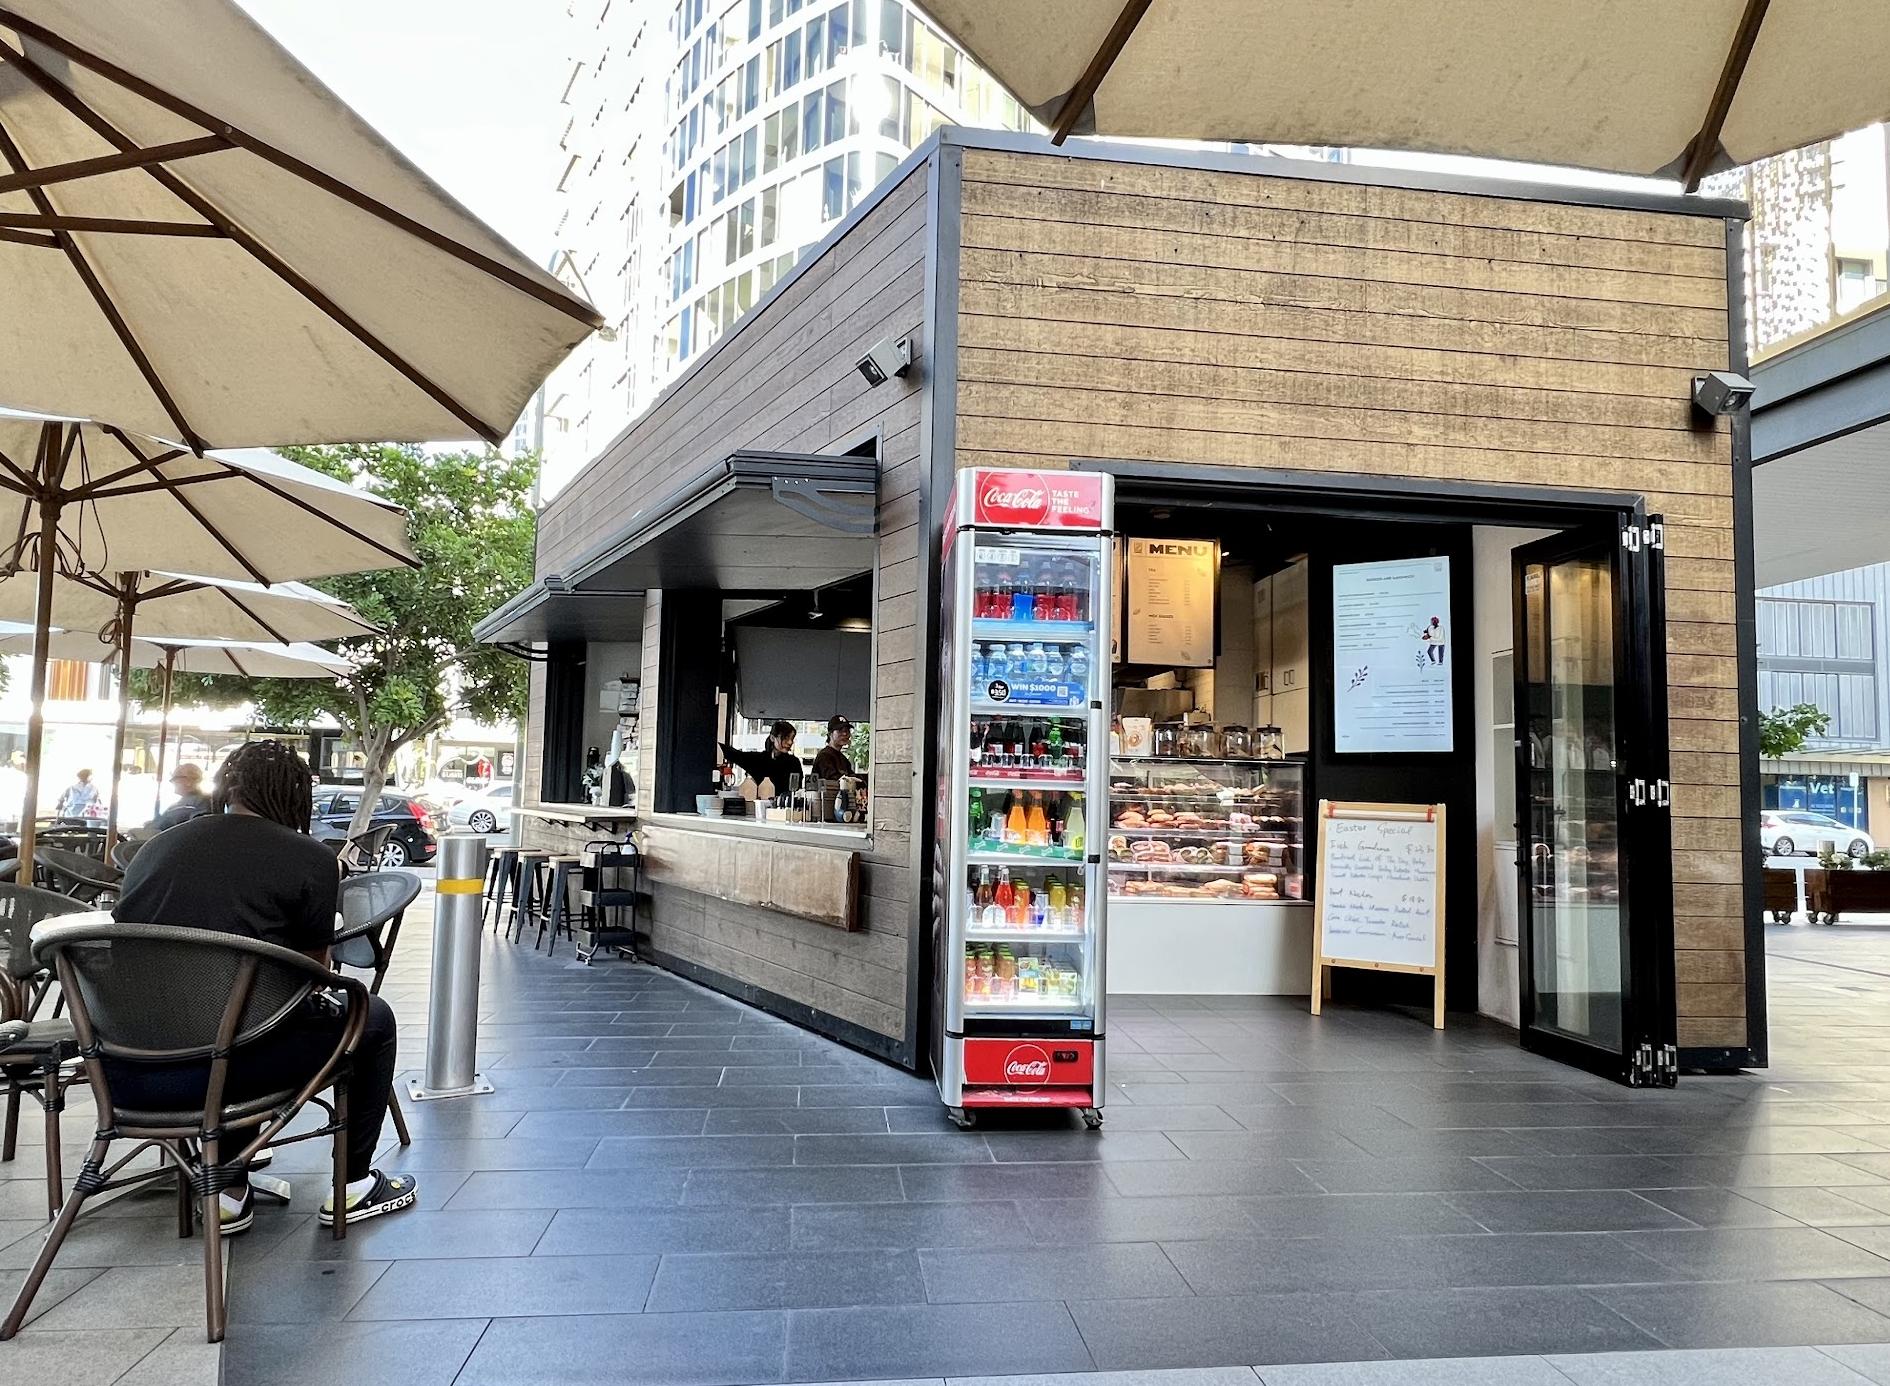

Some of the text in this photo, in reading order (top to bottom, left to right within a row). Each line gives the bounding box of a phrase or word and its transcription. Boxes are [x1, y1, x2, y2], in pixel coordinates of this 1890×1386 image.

[984, 487, 1046, 509] Coca-Cola
[1052, 490, 1079, 498] TASTE
[1052, 498, 1069, 506] THE
[1052, 506, 1090, 515] FEELING
[1149, 543, 1208, 556] MENU
[1011, 683, 1056, 693] WIN $1000
[1809, 782, 1835, 794] Vet
[1336, 822, 1413, 838] Easter Special
[1007, 1060, 1048, 1076] Coca-Cola
[381, 1191, 416, 1213] crocs
